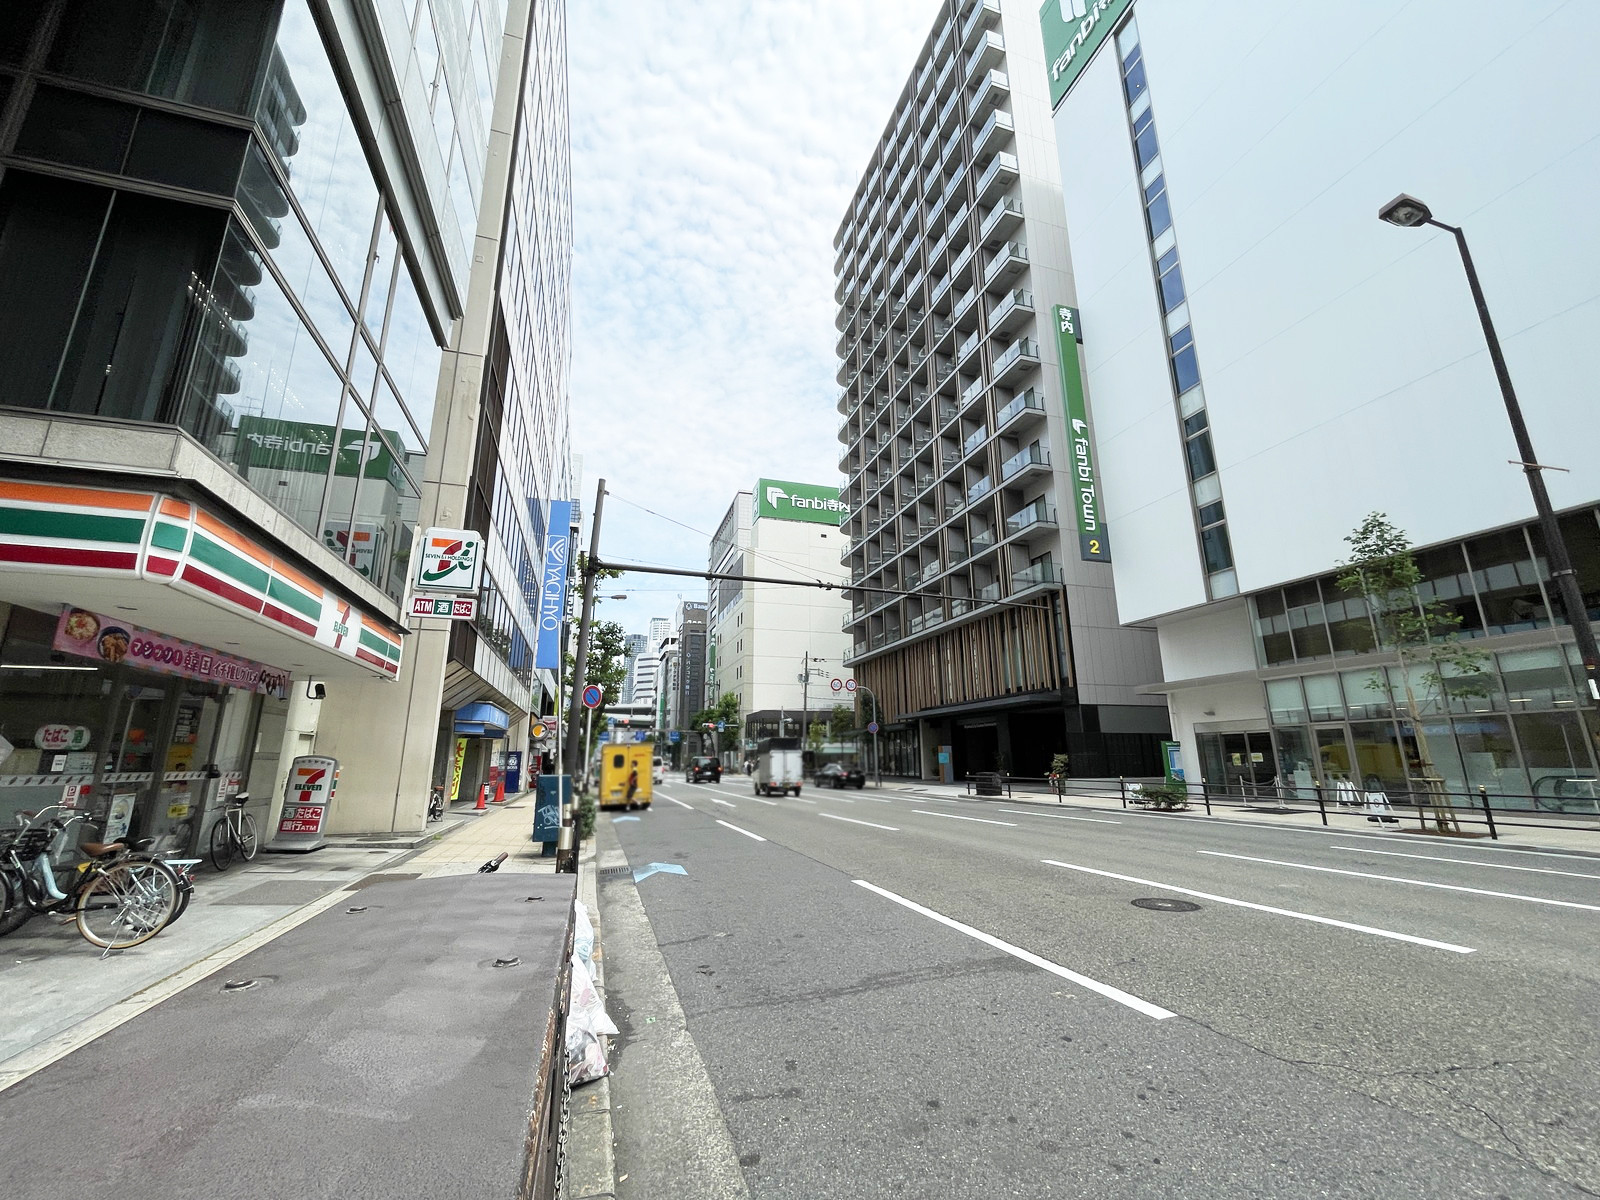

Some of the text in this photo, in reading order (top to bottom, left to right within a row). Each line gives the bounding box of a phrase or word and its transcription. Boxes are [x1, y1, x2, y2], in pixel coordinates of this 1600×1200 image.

[1059, 308, 1074, 333] 寺内
[1074, 437, 1100, 554] fanbi Town 2
[415, 600, 472, 614] ATM 酒 たばこ
[42, 728, 69, 742] たばこ
[284, 808, 321, 819] 酒 たばこ
